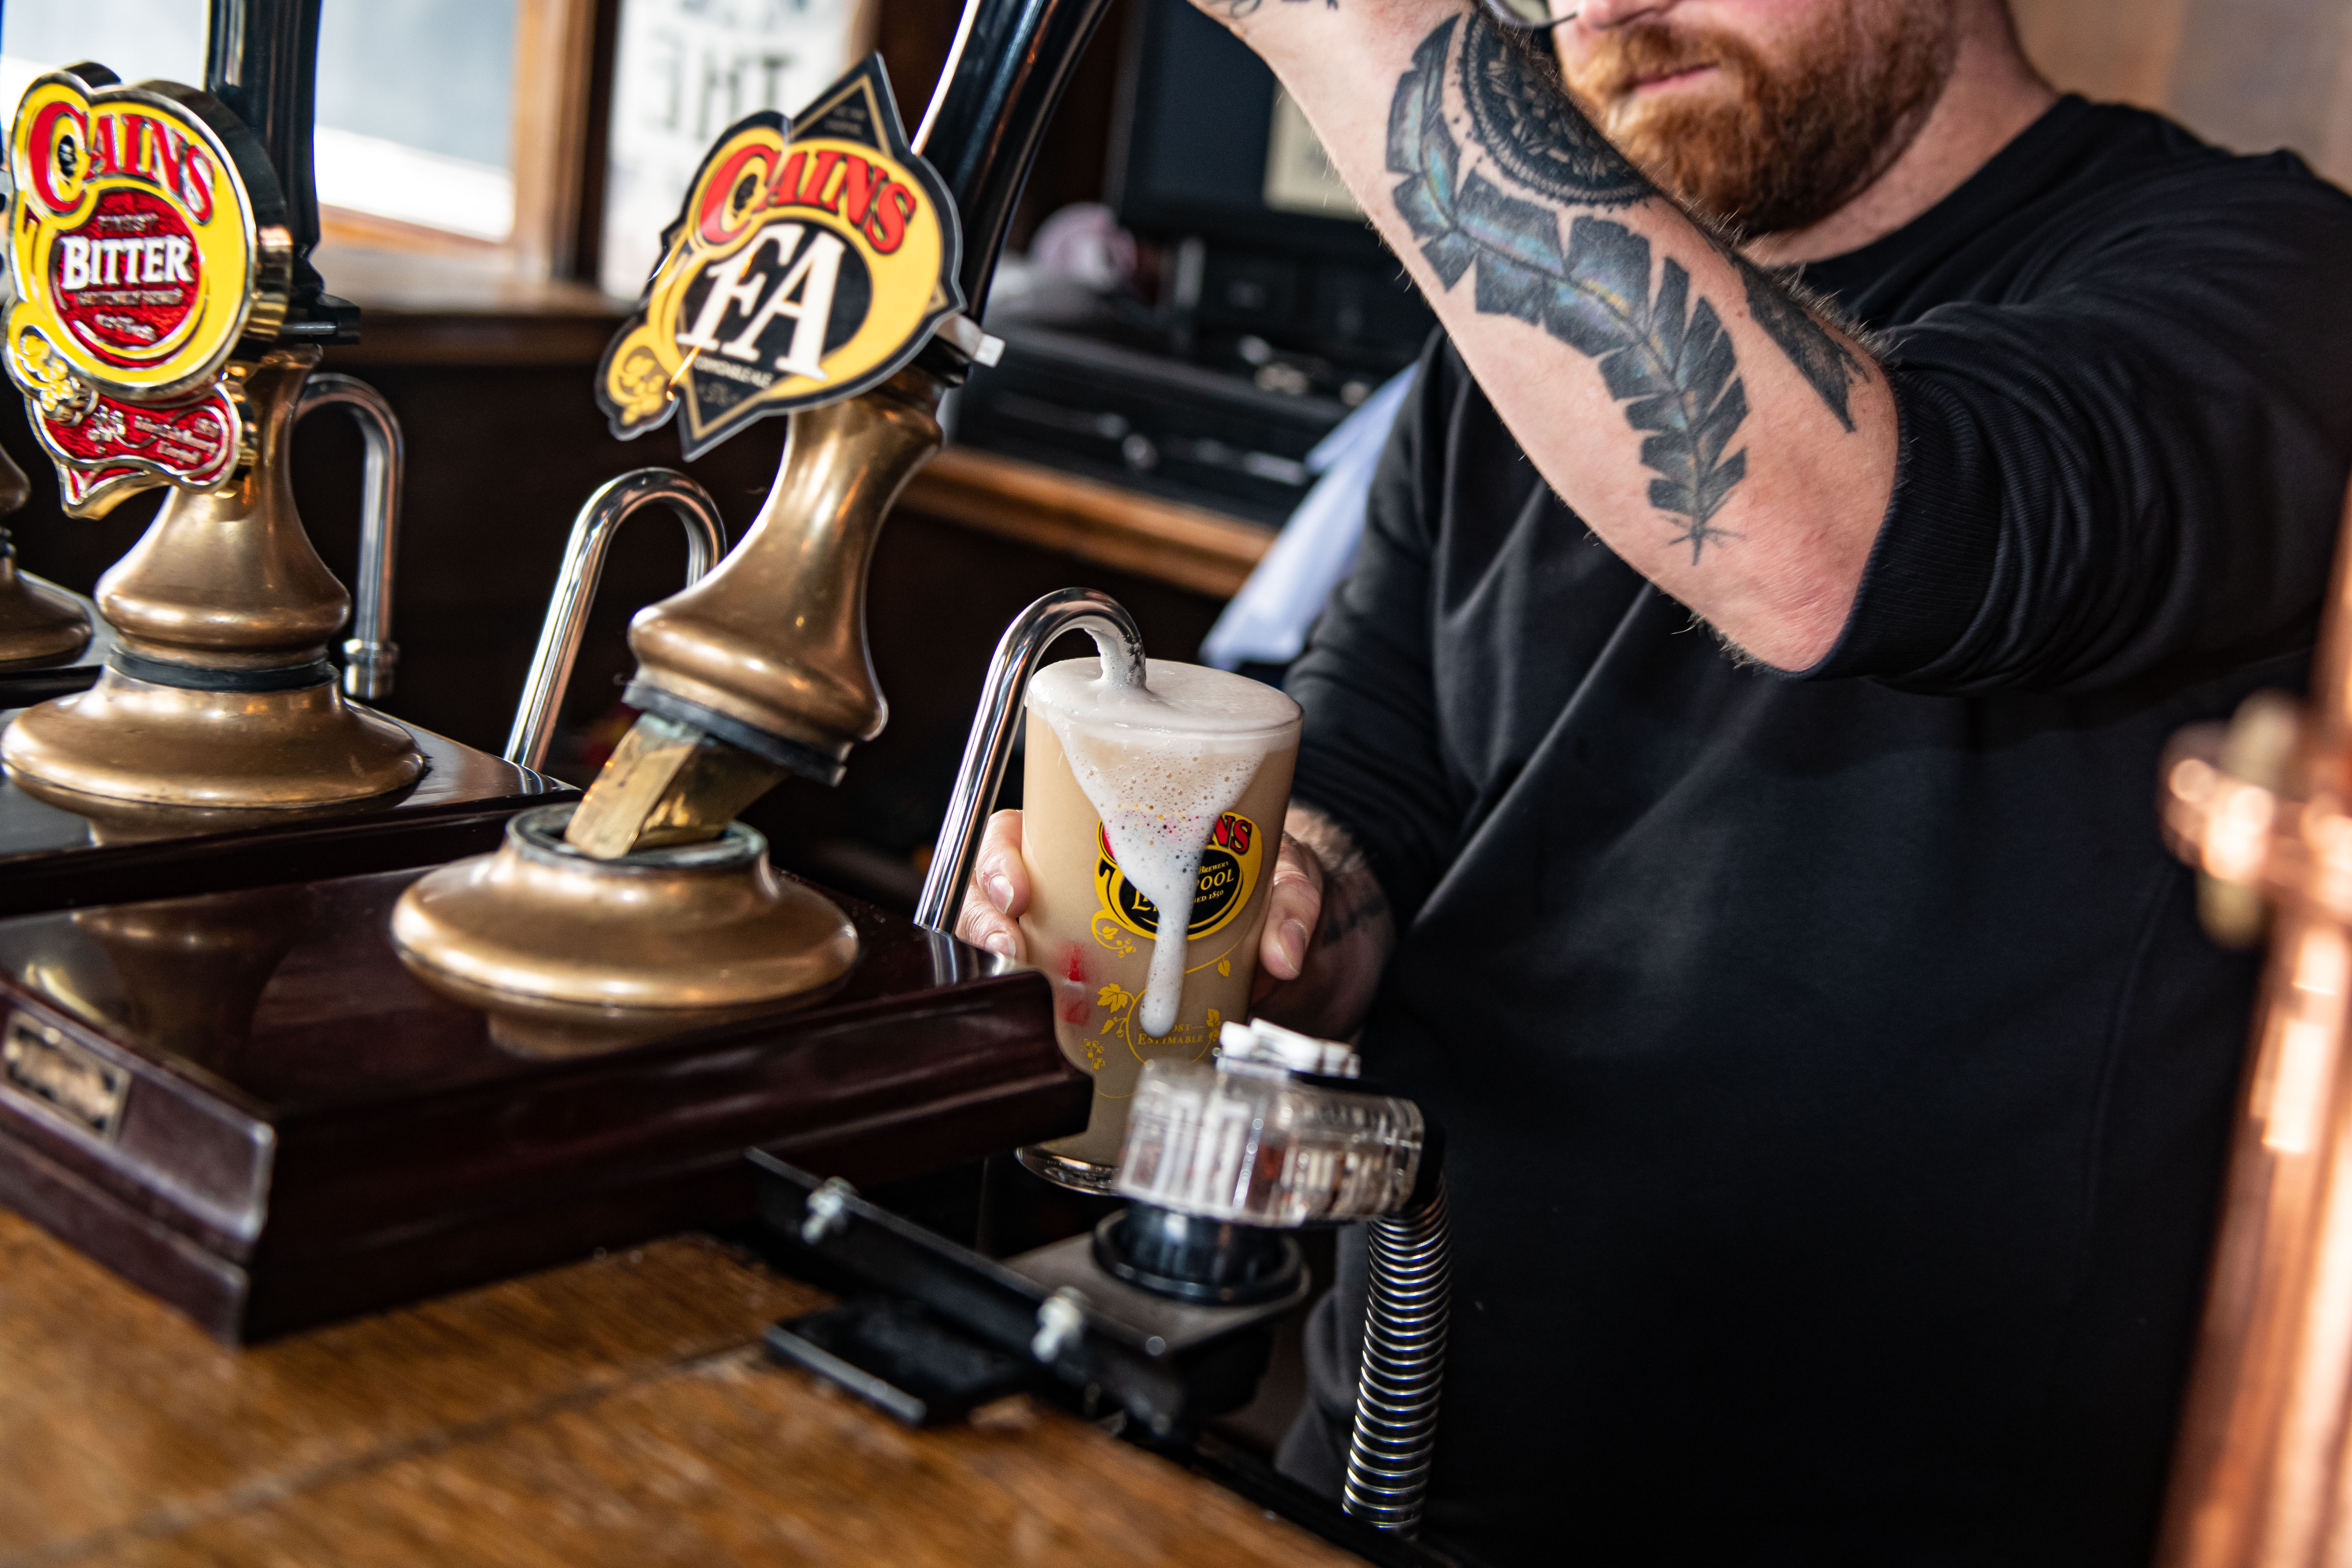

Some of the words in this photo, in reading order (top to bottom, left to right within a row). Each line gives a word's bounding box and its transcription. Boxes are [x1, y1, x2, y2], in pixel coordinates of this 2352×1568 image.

[28, 101, 215, 221] CAINS
[699, 144, 917, 255] CAINS
[60, 234, 195, 291] BITTER
[676, 224, 846, 380] FA
[1199, 861, 1229, 874] BREWERY
